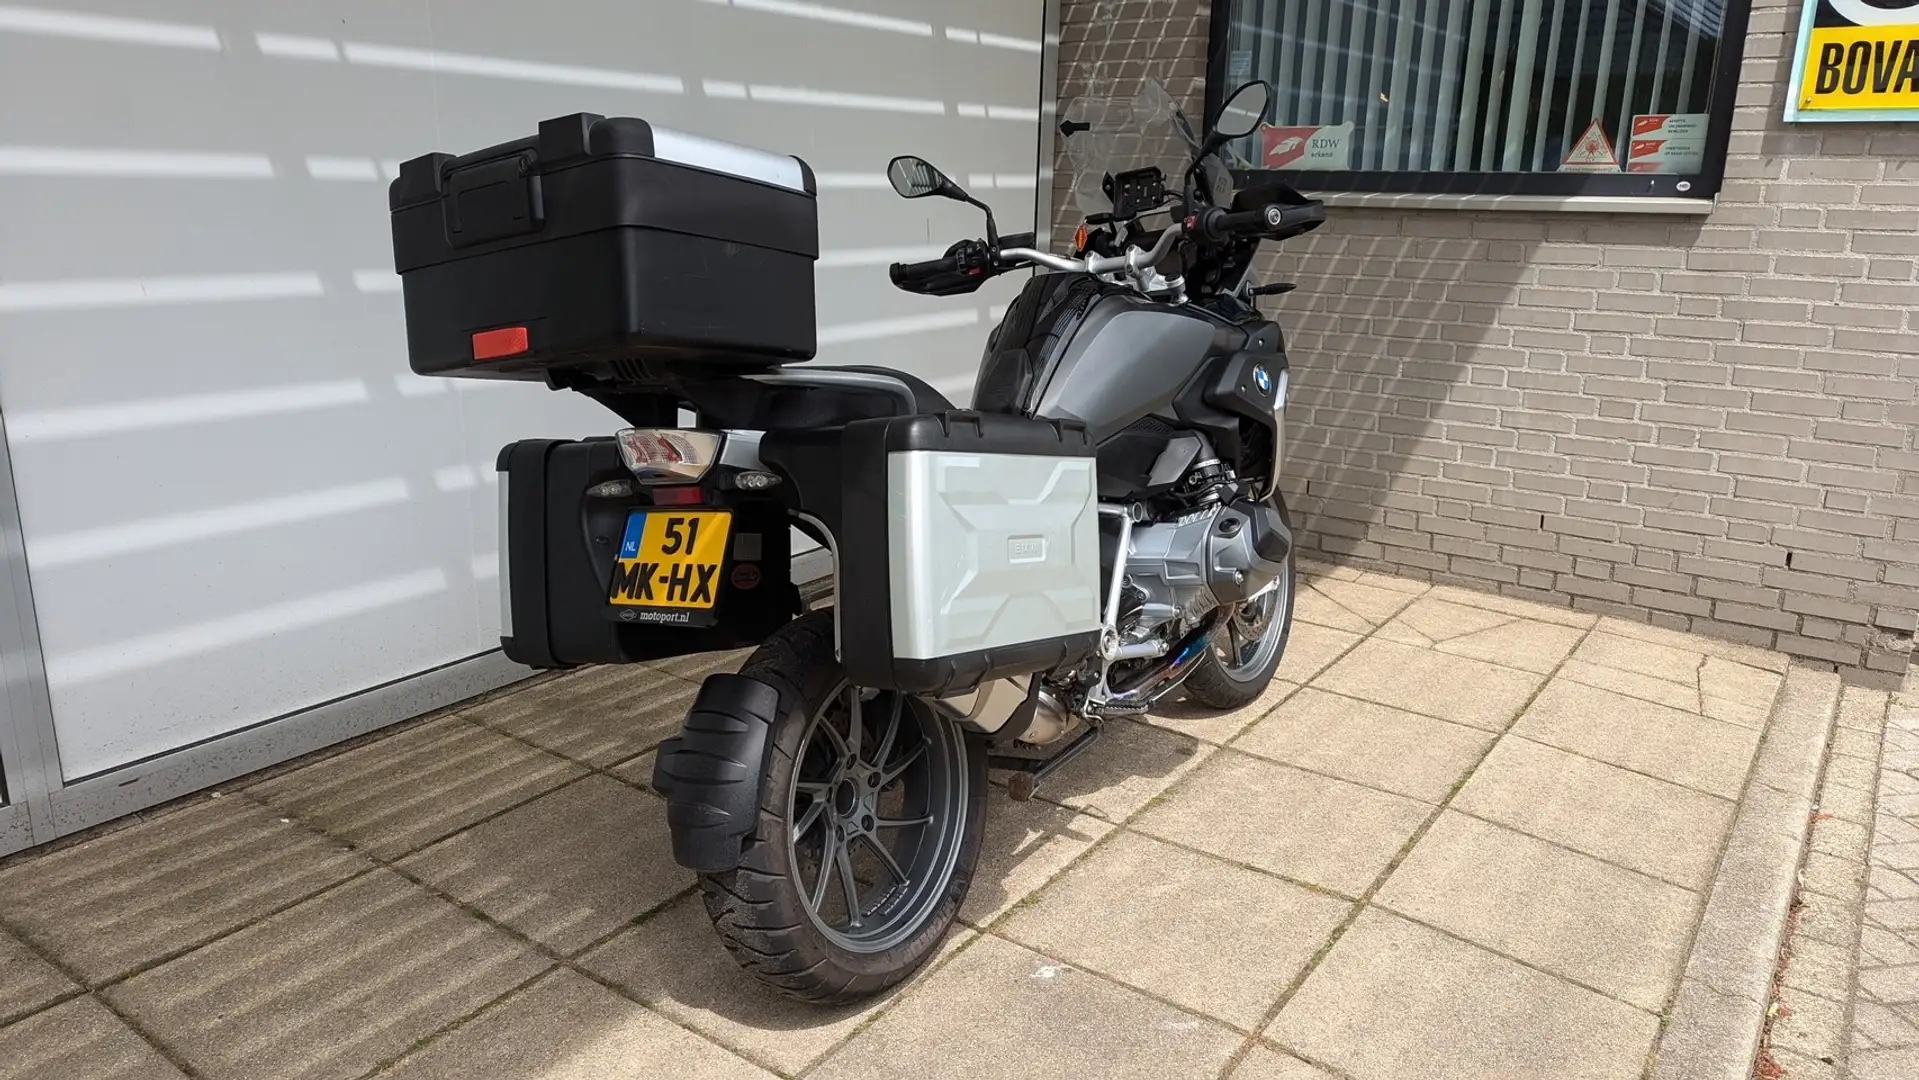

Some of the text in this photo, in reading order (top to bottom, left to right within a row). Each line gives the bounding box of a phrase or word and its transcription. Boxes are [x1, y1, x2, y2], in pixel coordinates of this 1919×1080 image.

[1815, 40, 1919, 95] BOVA
[1312, 139, 1341, 149] RDW
[625, 541, 636, 552] NL
[661, 518, 699, 555] 51
[611, 562, 718, 603] MK-HX
[640, 612, 690, 624] motoport.nl
